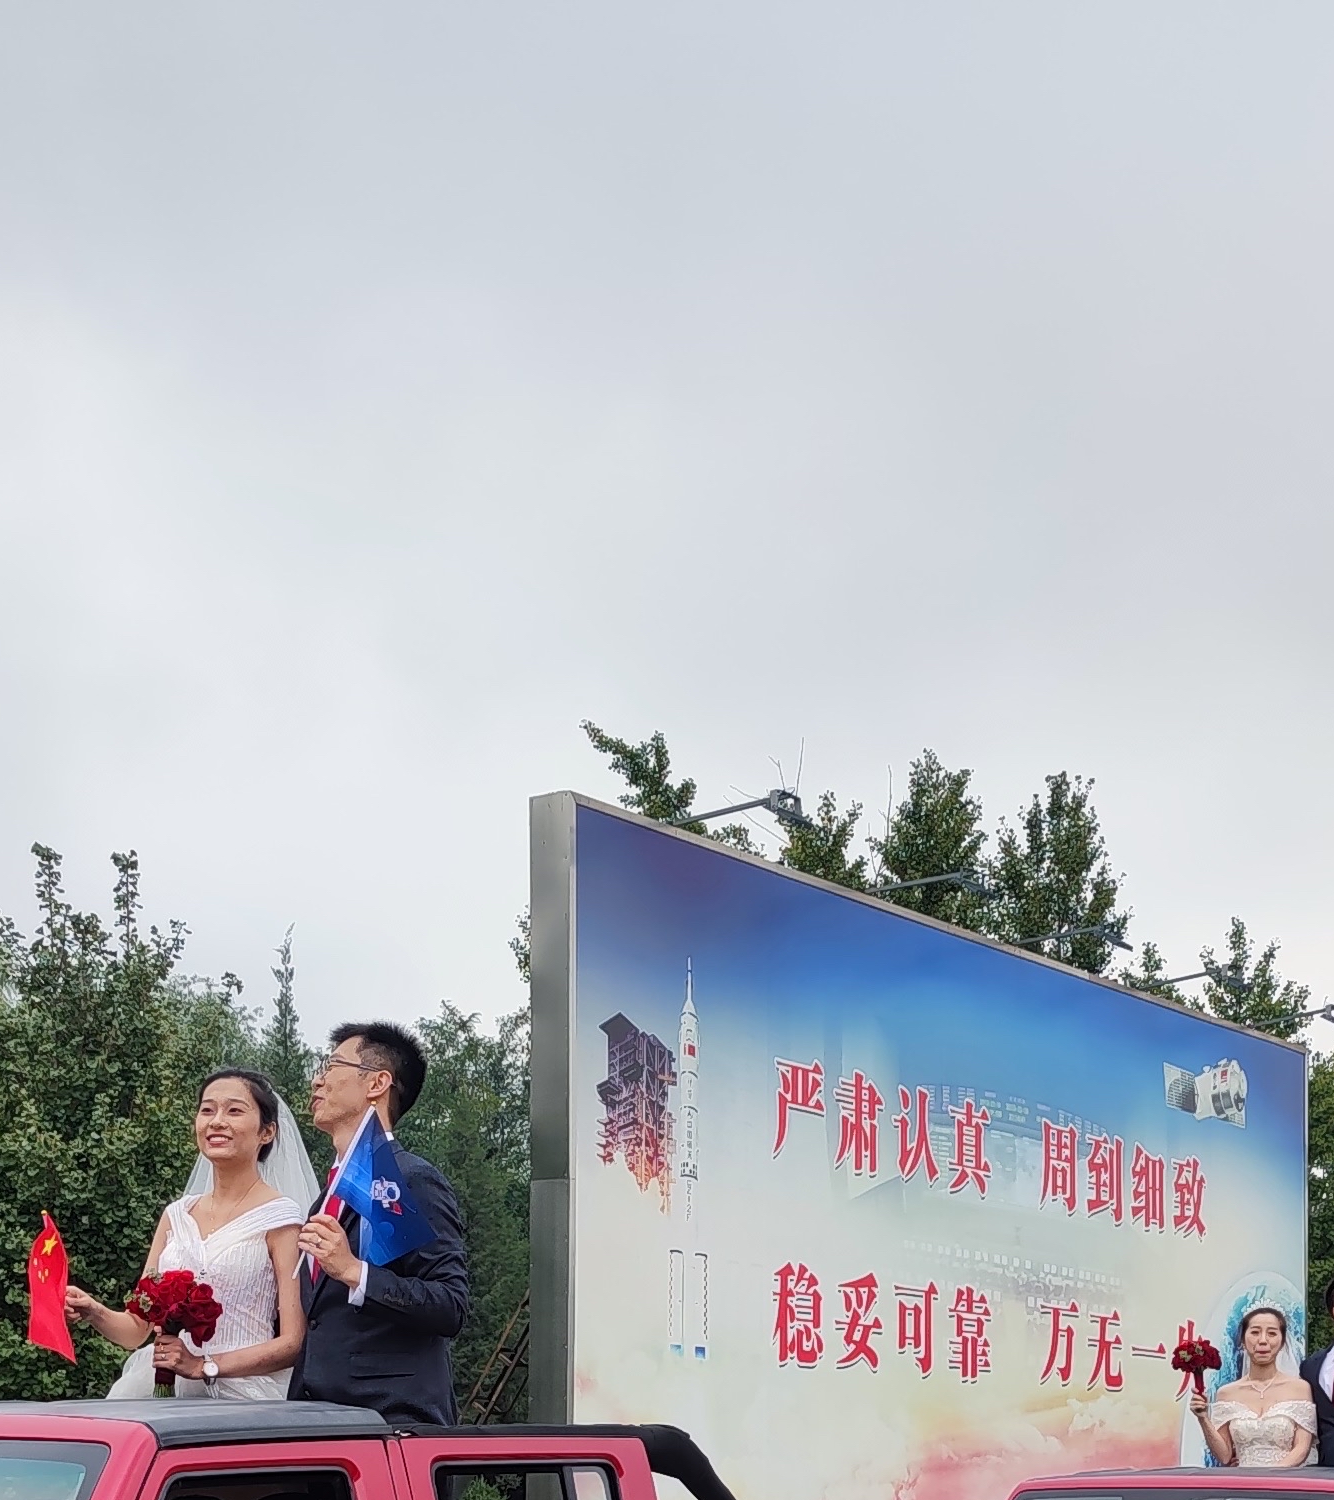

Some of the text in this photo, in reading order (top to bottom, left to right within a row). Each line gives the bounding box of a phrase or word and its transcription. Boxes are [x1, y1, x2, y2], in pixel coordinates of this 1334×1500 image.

[772, 1059, 1208, 1242] 严肃认真 周到细致
[771, 1261, 992, 1384] 稳妥可靠
